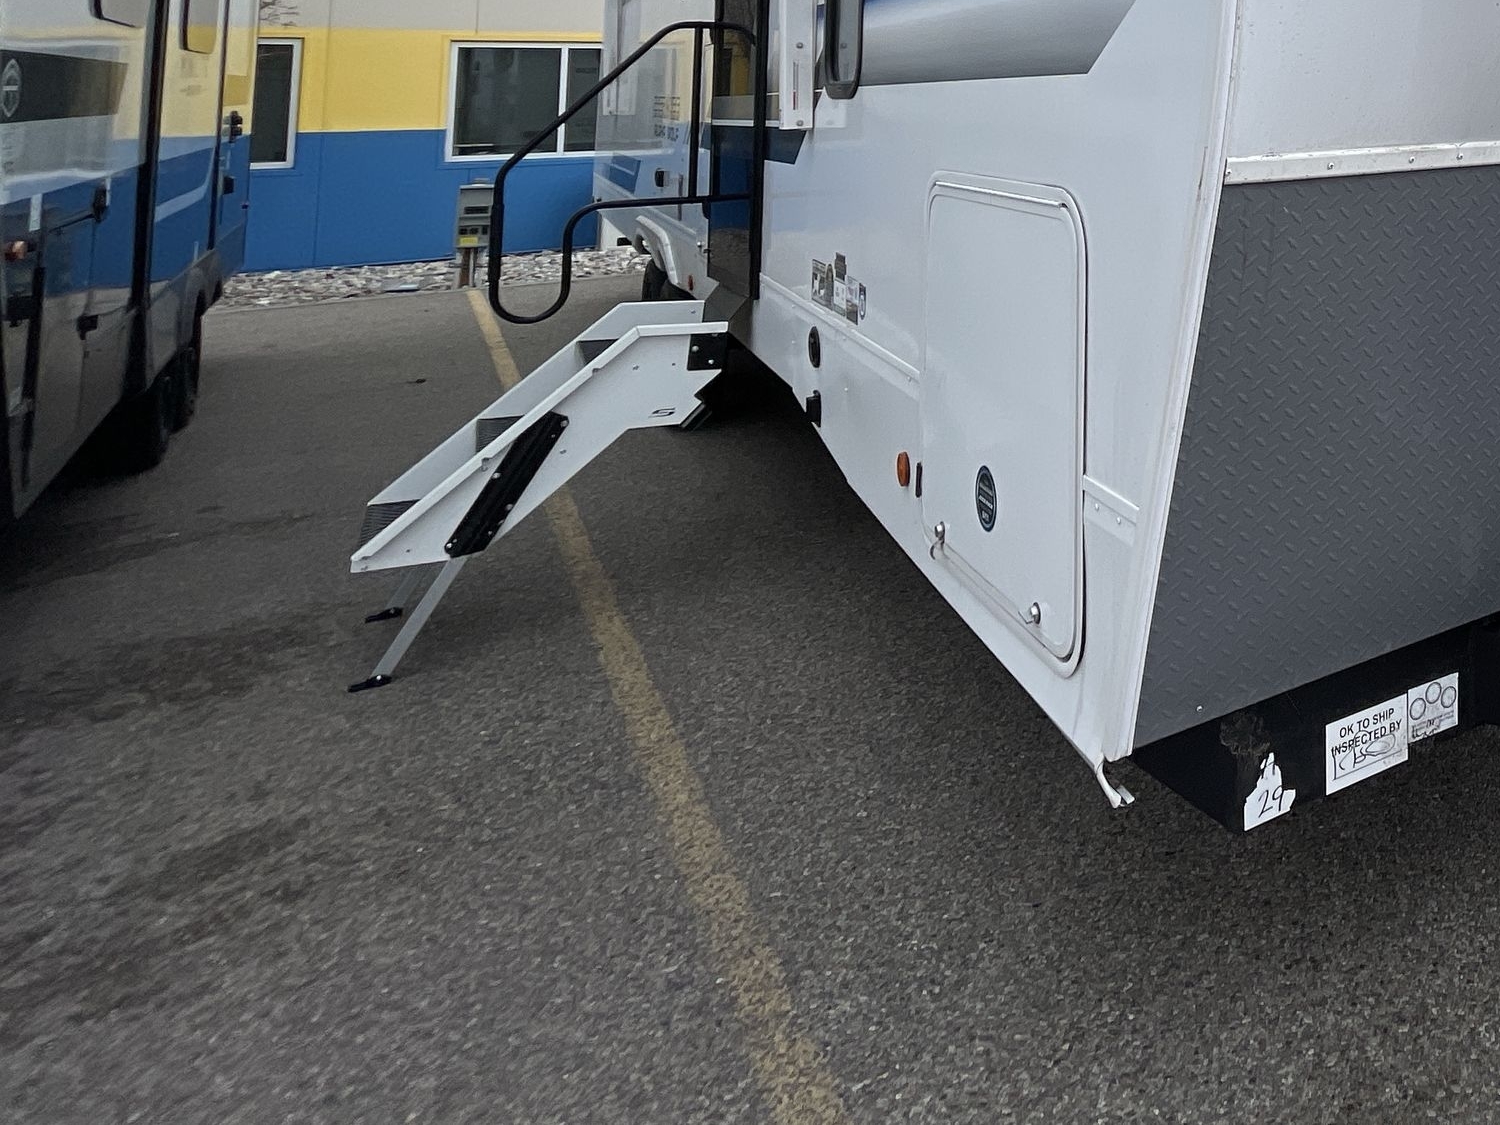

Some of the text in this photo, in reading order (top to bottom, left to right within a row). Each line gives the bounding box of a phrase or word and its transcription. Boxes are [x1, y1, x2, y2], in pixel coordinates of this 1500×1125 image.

[1331, 727, 1387, 756] INSPECTED
[1390, 719, 1402, 733] BY
[1339, 708, 1395, 738] OK TO SHIP
[1258, 784, 1284, 818] 29
